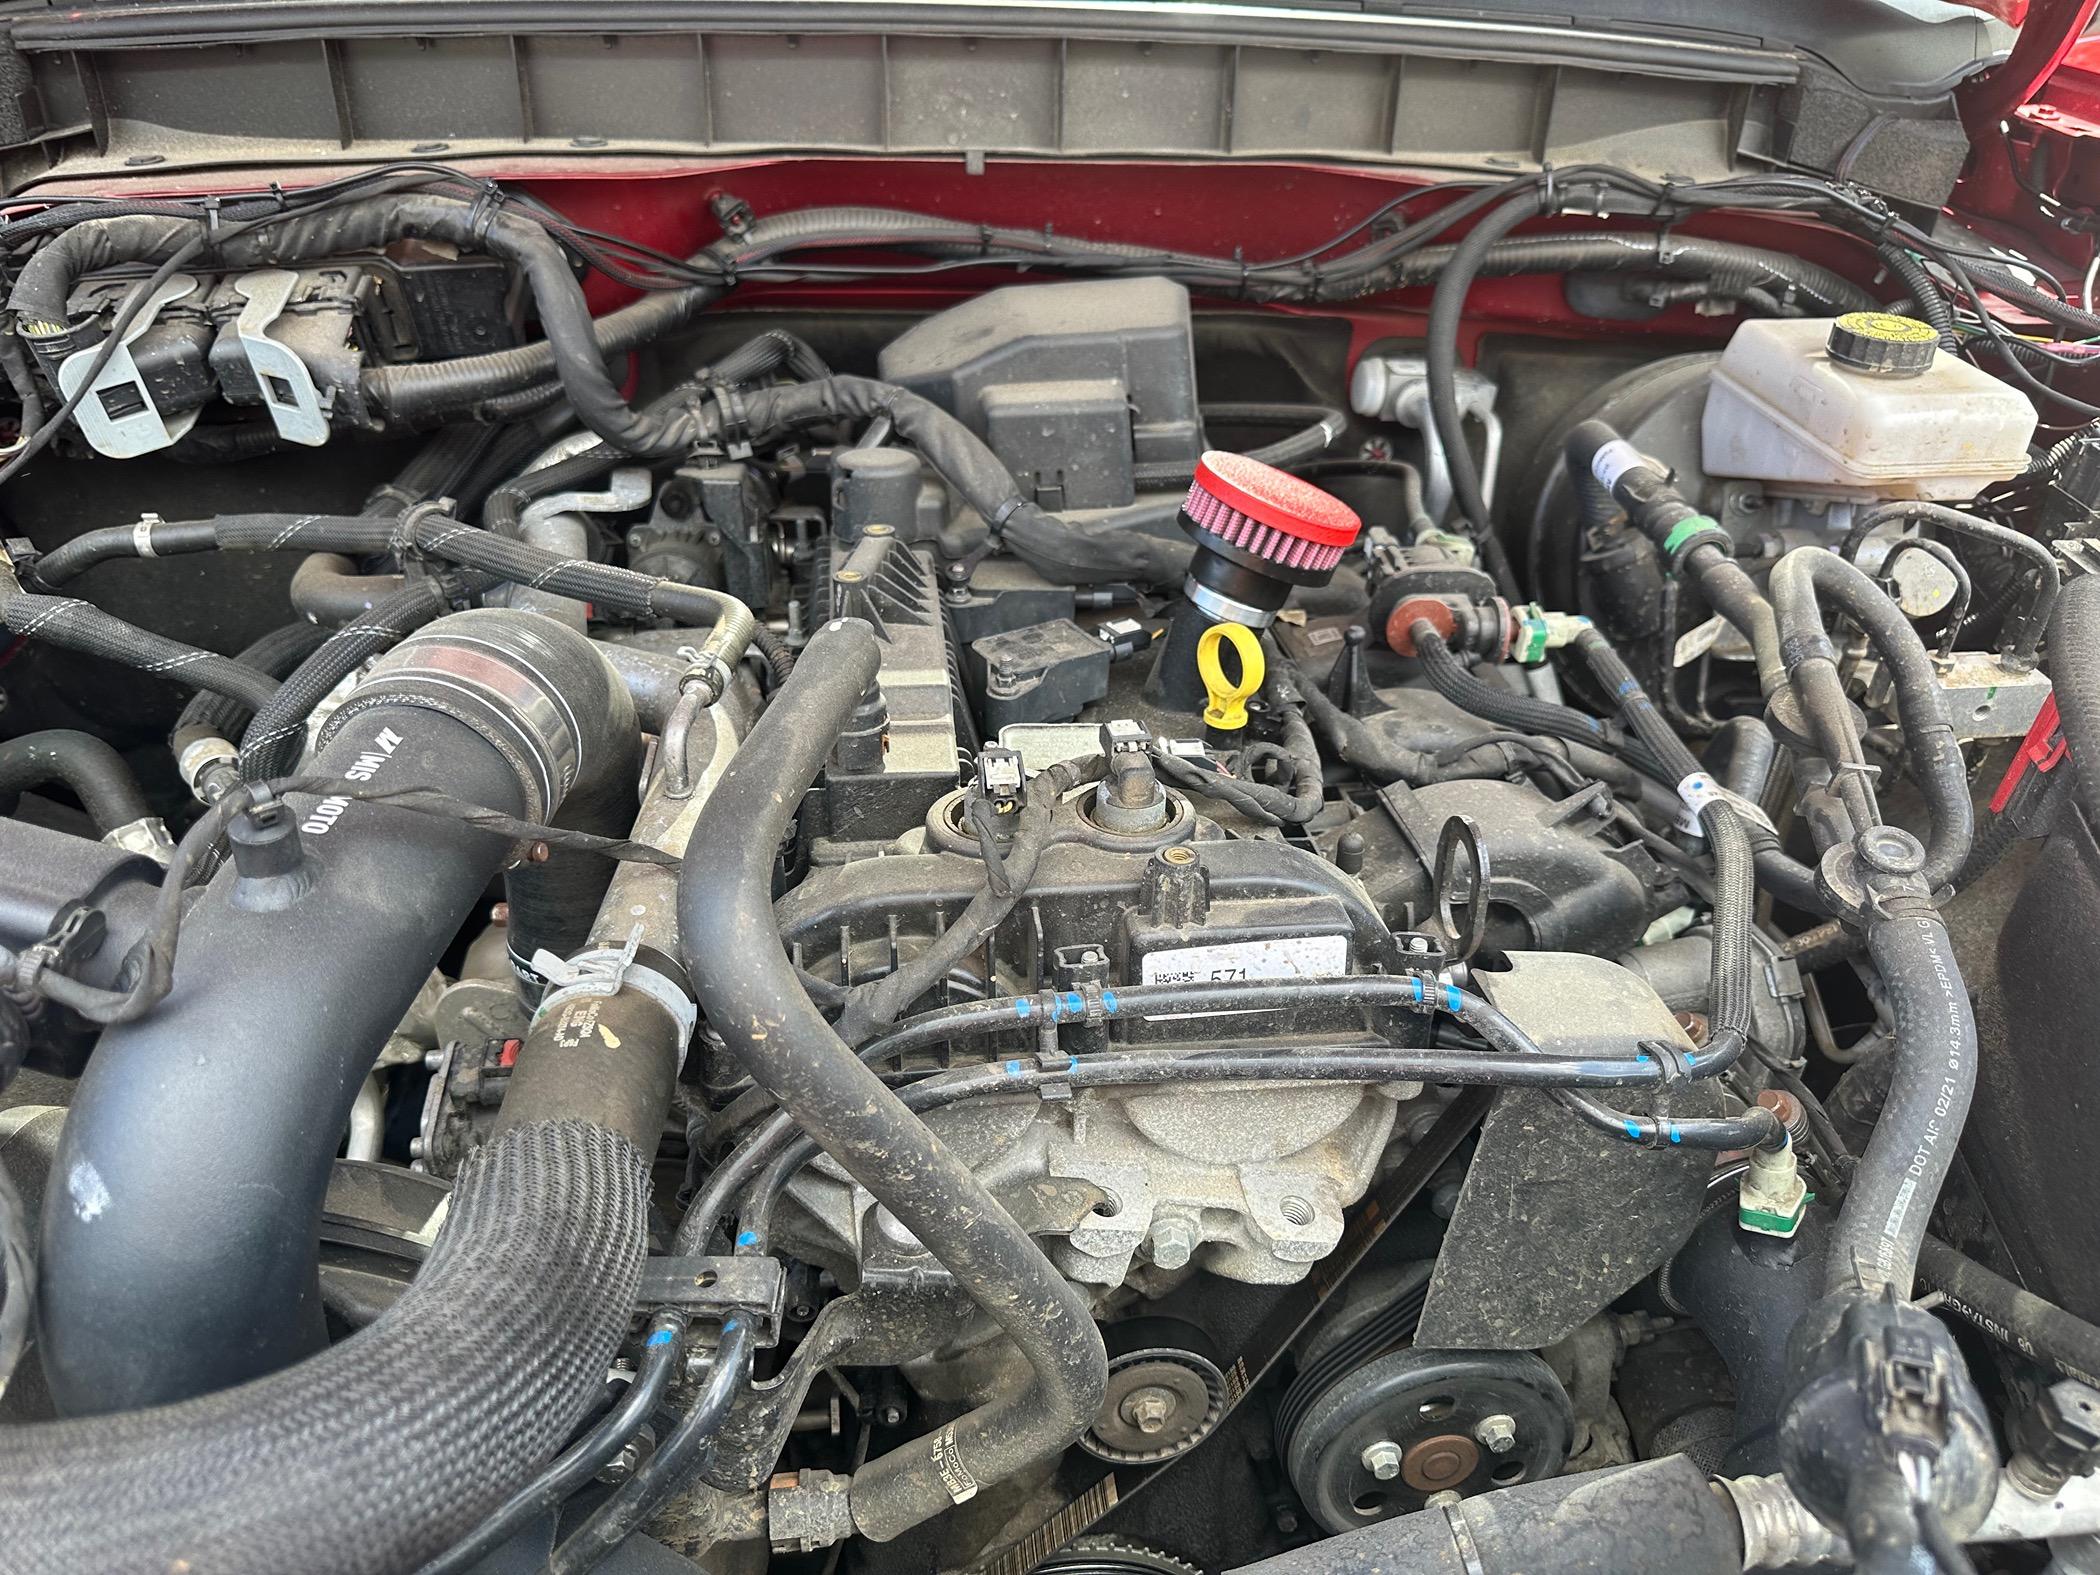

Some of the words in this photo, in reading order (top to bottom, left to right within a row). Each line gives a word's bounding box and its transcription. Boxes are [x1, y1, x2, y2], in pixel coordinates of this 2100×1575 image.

[301, 751, 389, 835] MISMOTO
[1921, 931, 1934, 946] VL
[1934, 1076, 1957, 1118] 02/21
[1908, 1144, 1931, 1177] DOT
